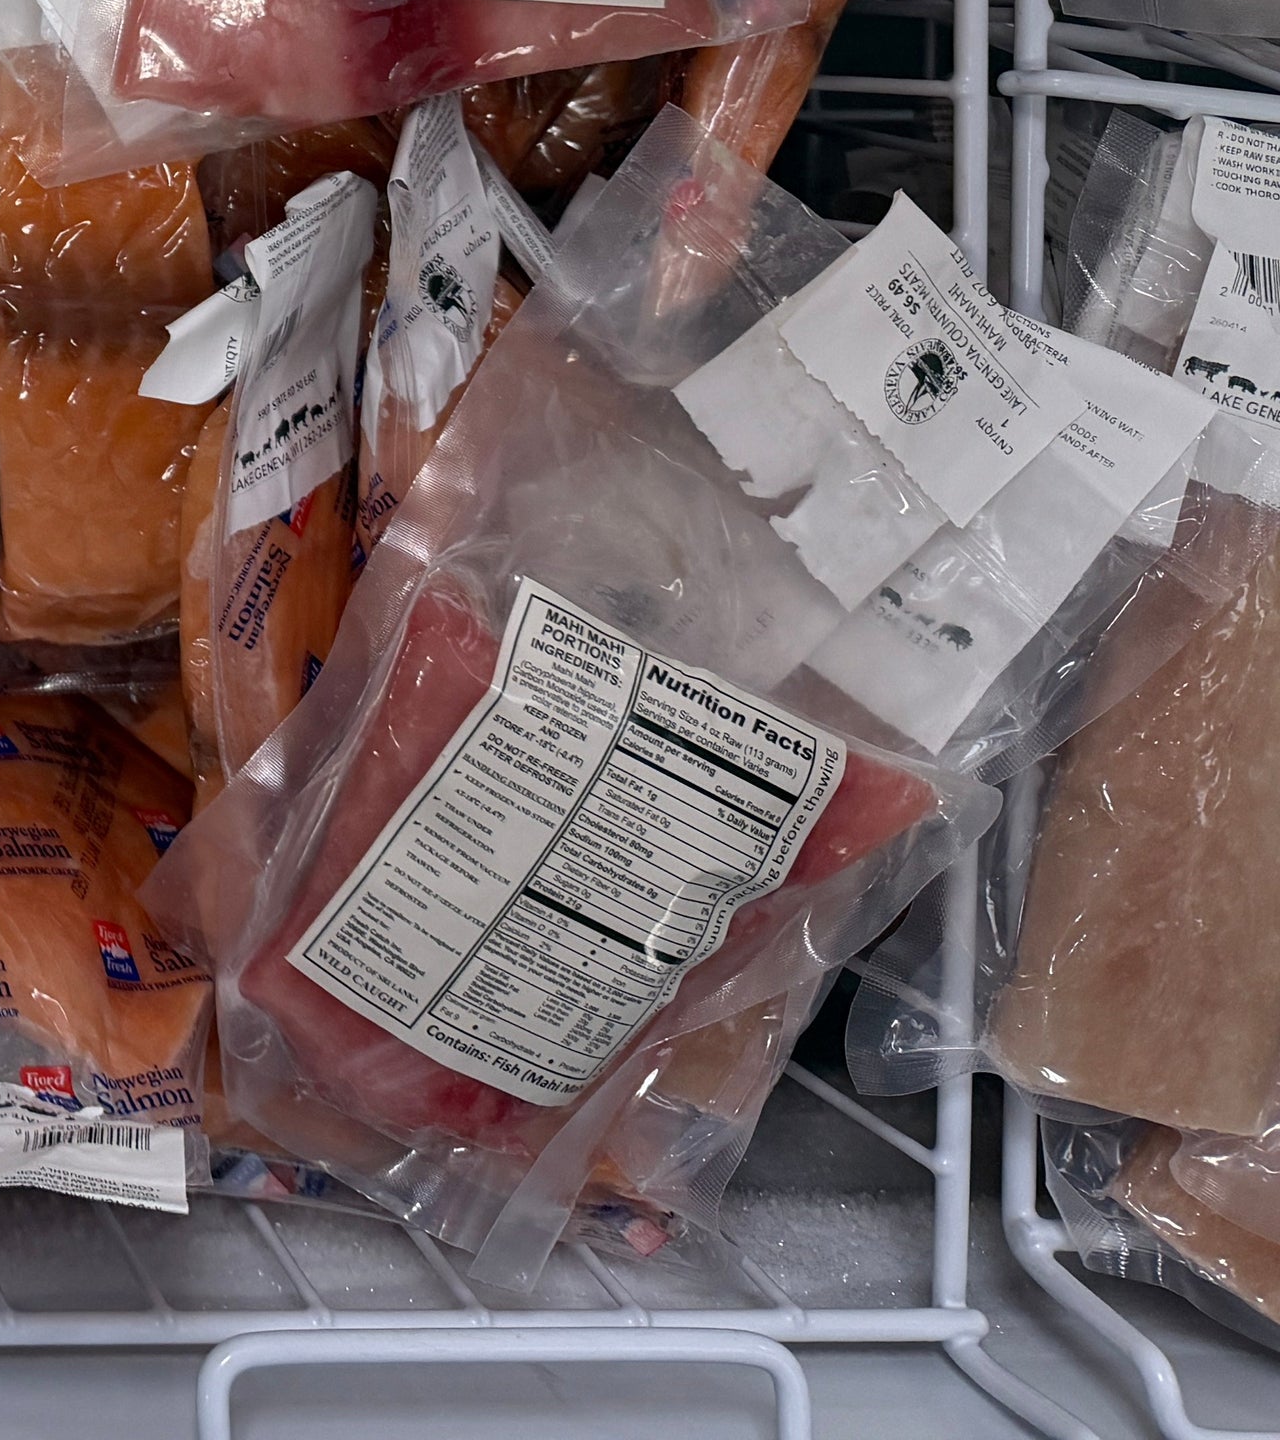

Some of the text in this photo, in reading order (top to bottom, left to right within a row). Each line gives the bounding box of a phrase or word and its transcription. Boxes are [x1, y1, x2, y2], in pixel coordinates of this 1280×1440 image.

[886, 277, 921, 316] $6.49
[946, 281, 1008, 352] MAHI-MAHI
[897, 261, 1028, 417] LAKE GENEVA COUNTRY MEATS
[539, 622, 622, 674] PORTIONS
[544, 607, 626, 657] MAHI MAHI
[638, 688, 798, 781] Serving Size 4 oz Raw (113 grams)
[645, 664, 817, 761] Nutrition Facts
[97, 1086, 194, 1119] Salmon
